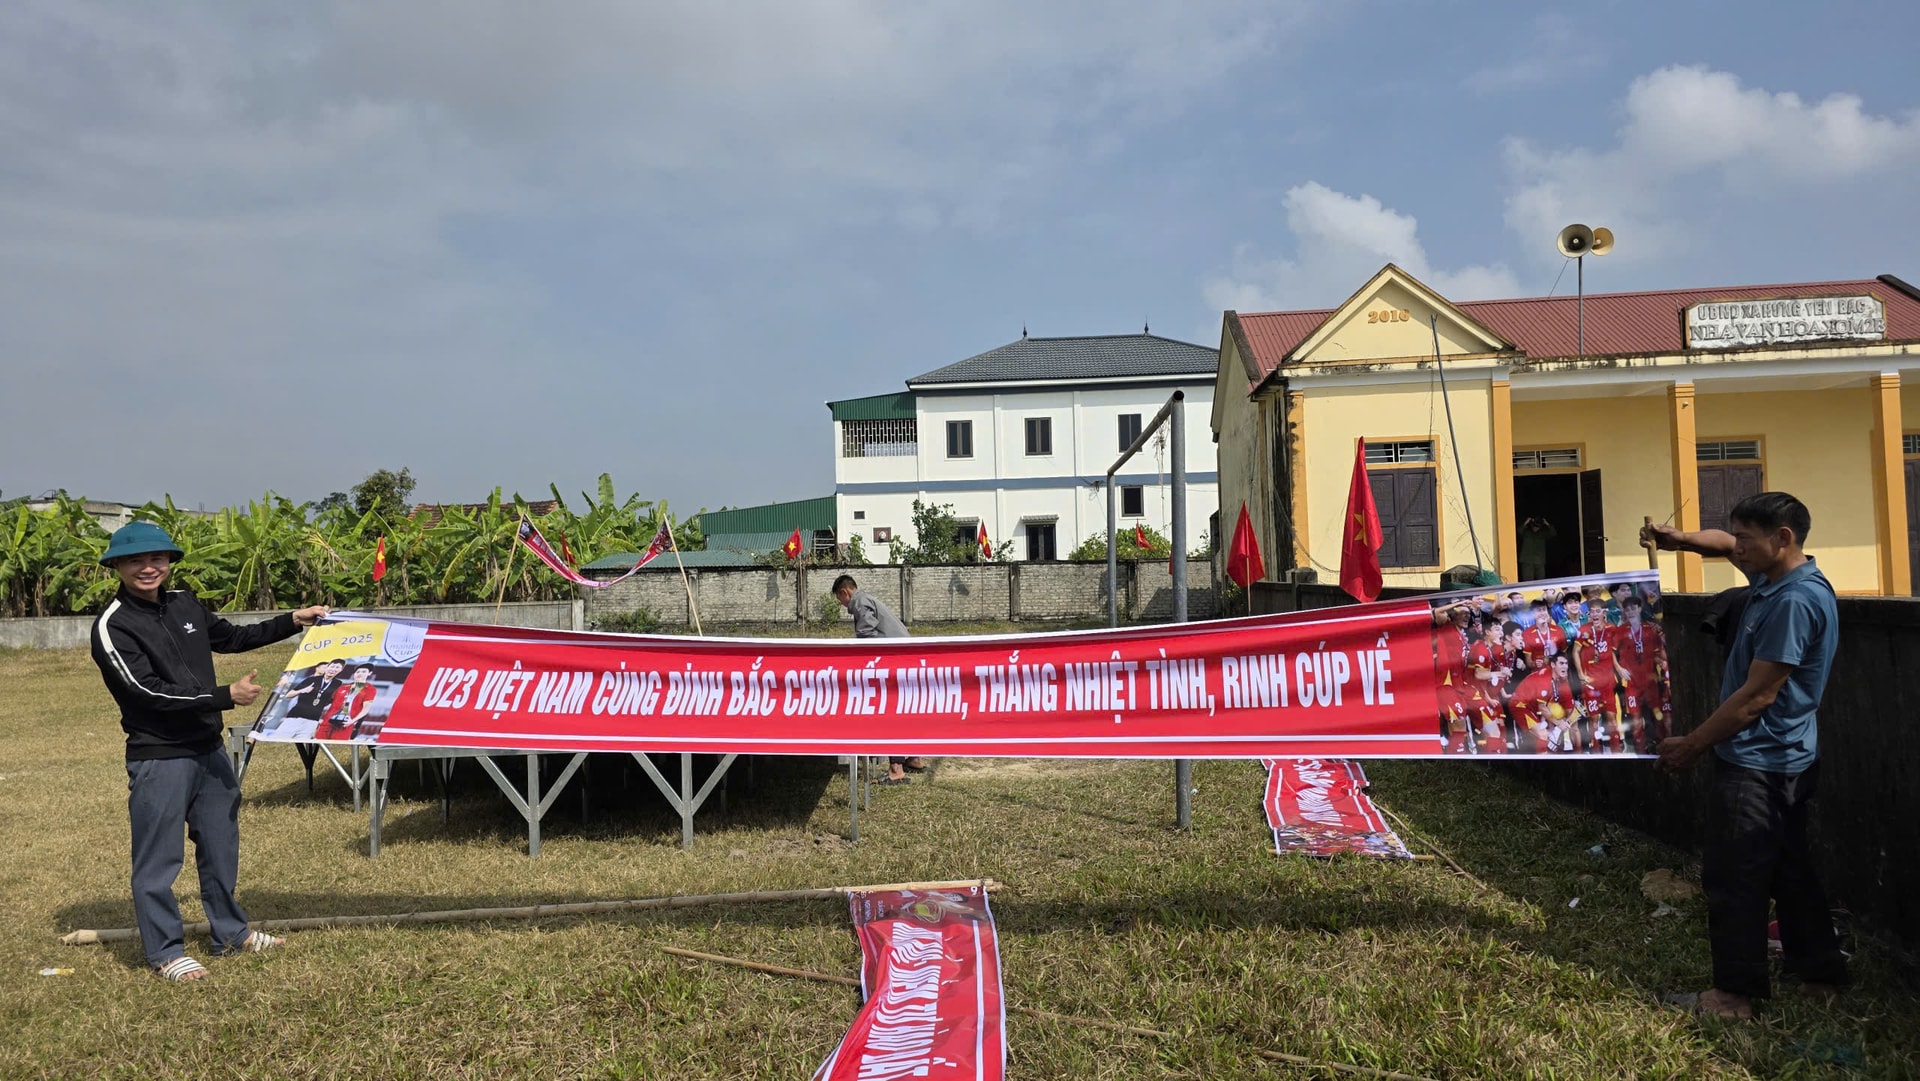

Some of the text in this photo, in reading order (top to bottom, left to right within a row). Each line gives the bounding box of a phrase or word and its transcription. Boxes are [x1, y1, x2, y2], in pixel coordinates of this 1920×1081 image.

[1367, 309, 1411, 324] 2016
[1697, 304, 1740, 321] UBND
[304, 639, 332, 652] CUP
[340, 633, 373, 646] 2025
[423, 667, 479, 710] U23
[474, 660, 536, 720] VIỆT
[528, 671, 594, 715] NAM
[726, 656, 777, 716] BẮC
[783, 665, 840, 717] CHƠI
[845, 656, 890, 715] HẾT
[896, 658, 969, 721] MÌNH,
[975, 649, 1058, 713] THẮNG
[1065, 650, 1138, 724] NHIỆT
[1146, 648, 1215, 717] TÌNH,
[1223, 653, 1289, 709] RINH
[1296, 641, 1351, 708] CÚP
[1357, 632, 1395, 706] VỀ
